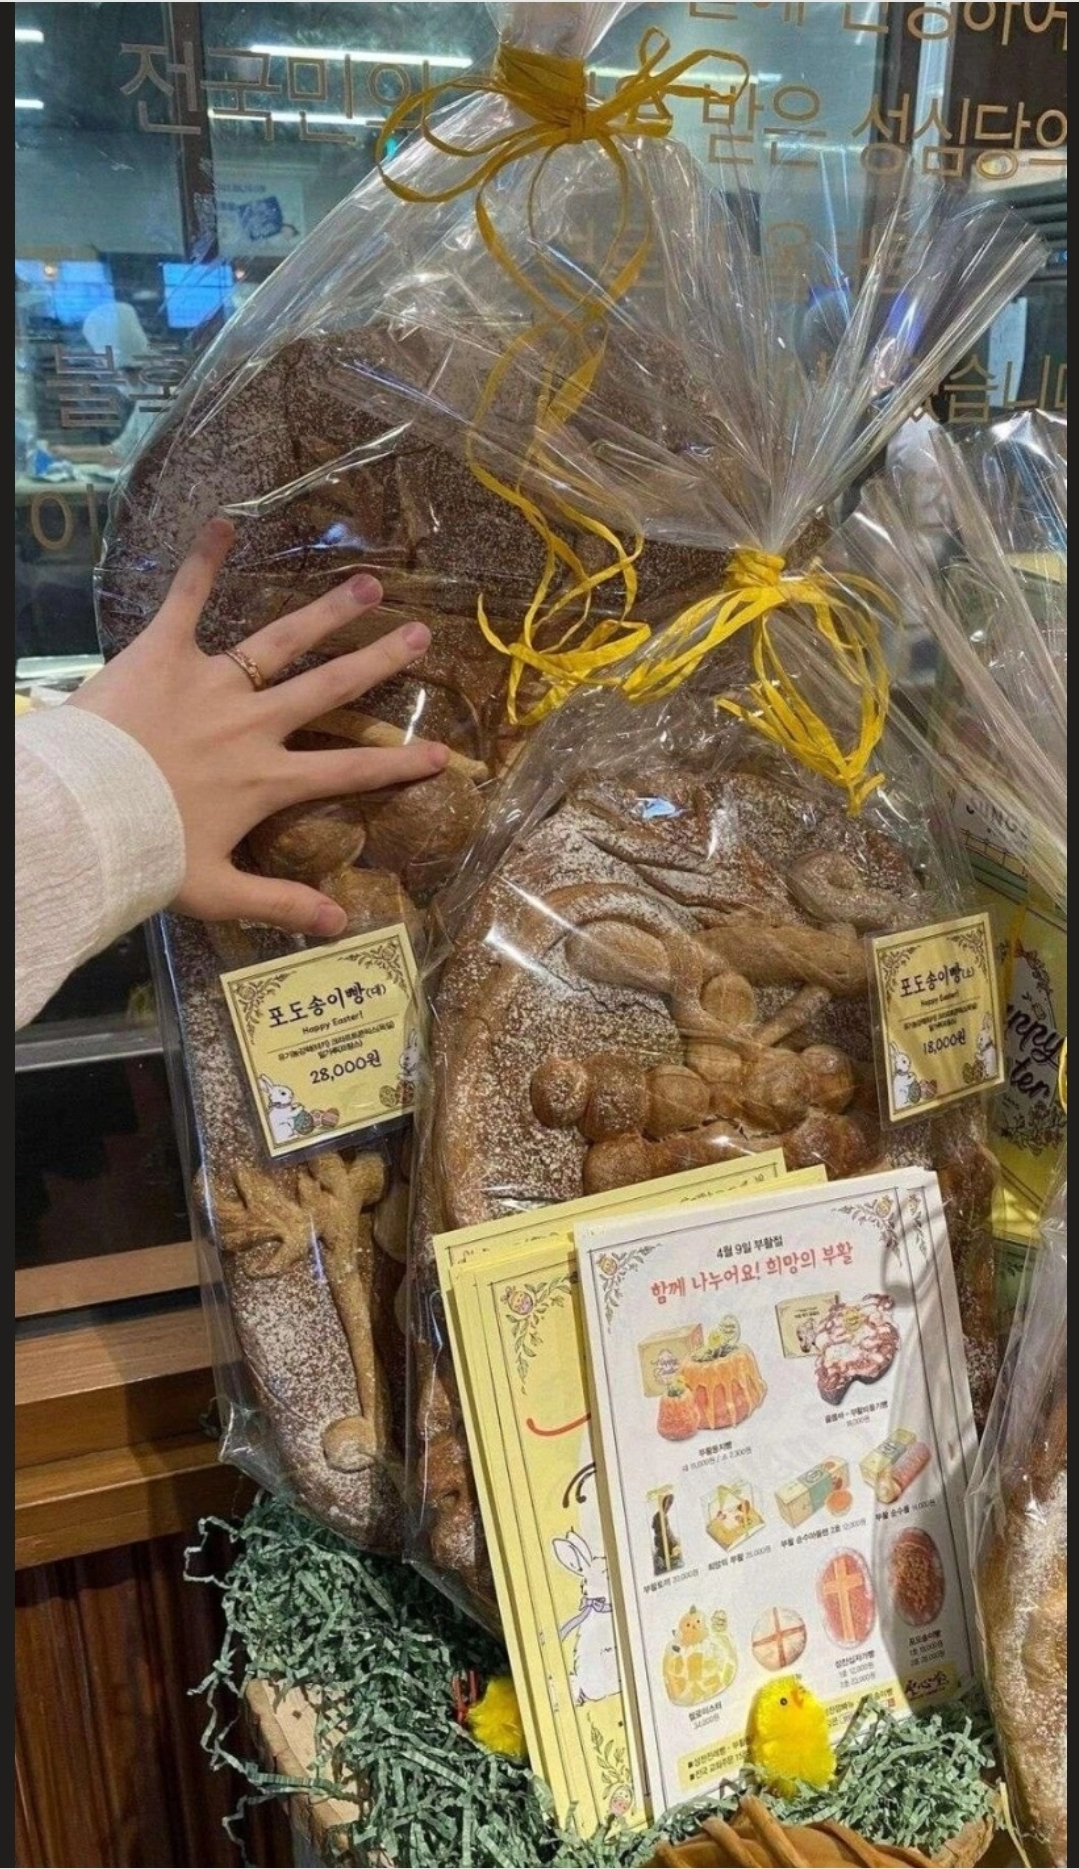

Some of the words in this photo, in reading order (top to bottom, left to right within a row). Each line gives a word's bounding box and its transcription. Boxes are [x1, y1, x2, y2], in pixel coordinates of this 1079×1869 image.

[703, 82, 827, 167] 받은
[268, 981, 387, 1028] 포도송이빵(대)
[302, 1020, 330, 1036] Happy
[332, 1010, 364, 1027] Easter!
[922, 1028, 967, 1056] 18,000원
[309, 1049, 382, 1085] 28,000원
[716, 1245, 733, 1259] 4월
[735, 1241, 751, 1256] 9일
[753, 1235, 784, 1251] 부활절
[651, 1279, 686, 1305] 함께
[691, 1263, 760, 1290] 나누어요!
[766, 1249, 816, 1276] 희망의
[822, 1241, 853, 1266] 부활
[875, 1512, 889, 1522] 부활
[781, 1537, 794, 1548] 부활
[730, 1553, 744, 1564] 부활
